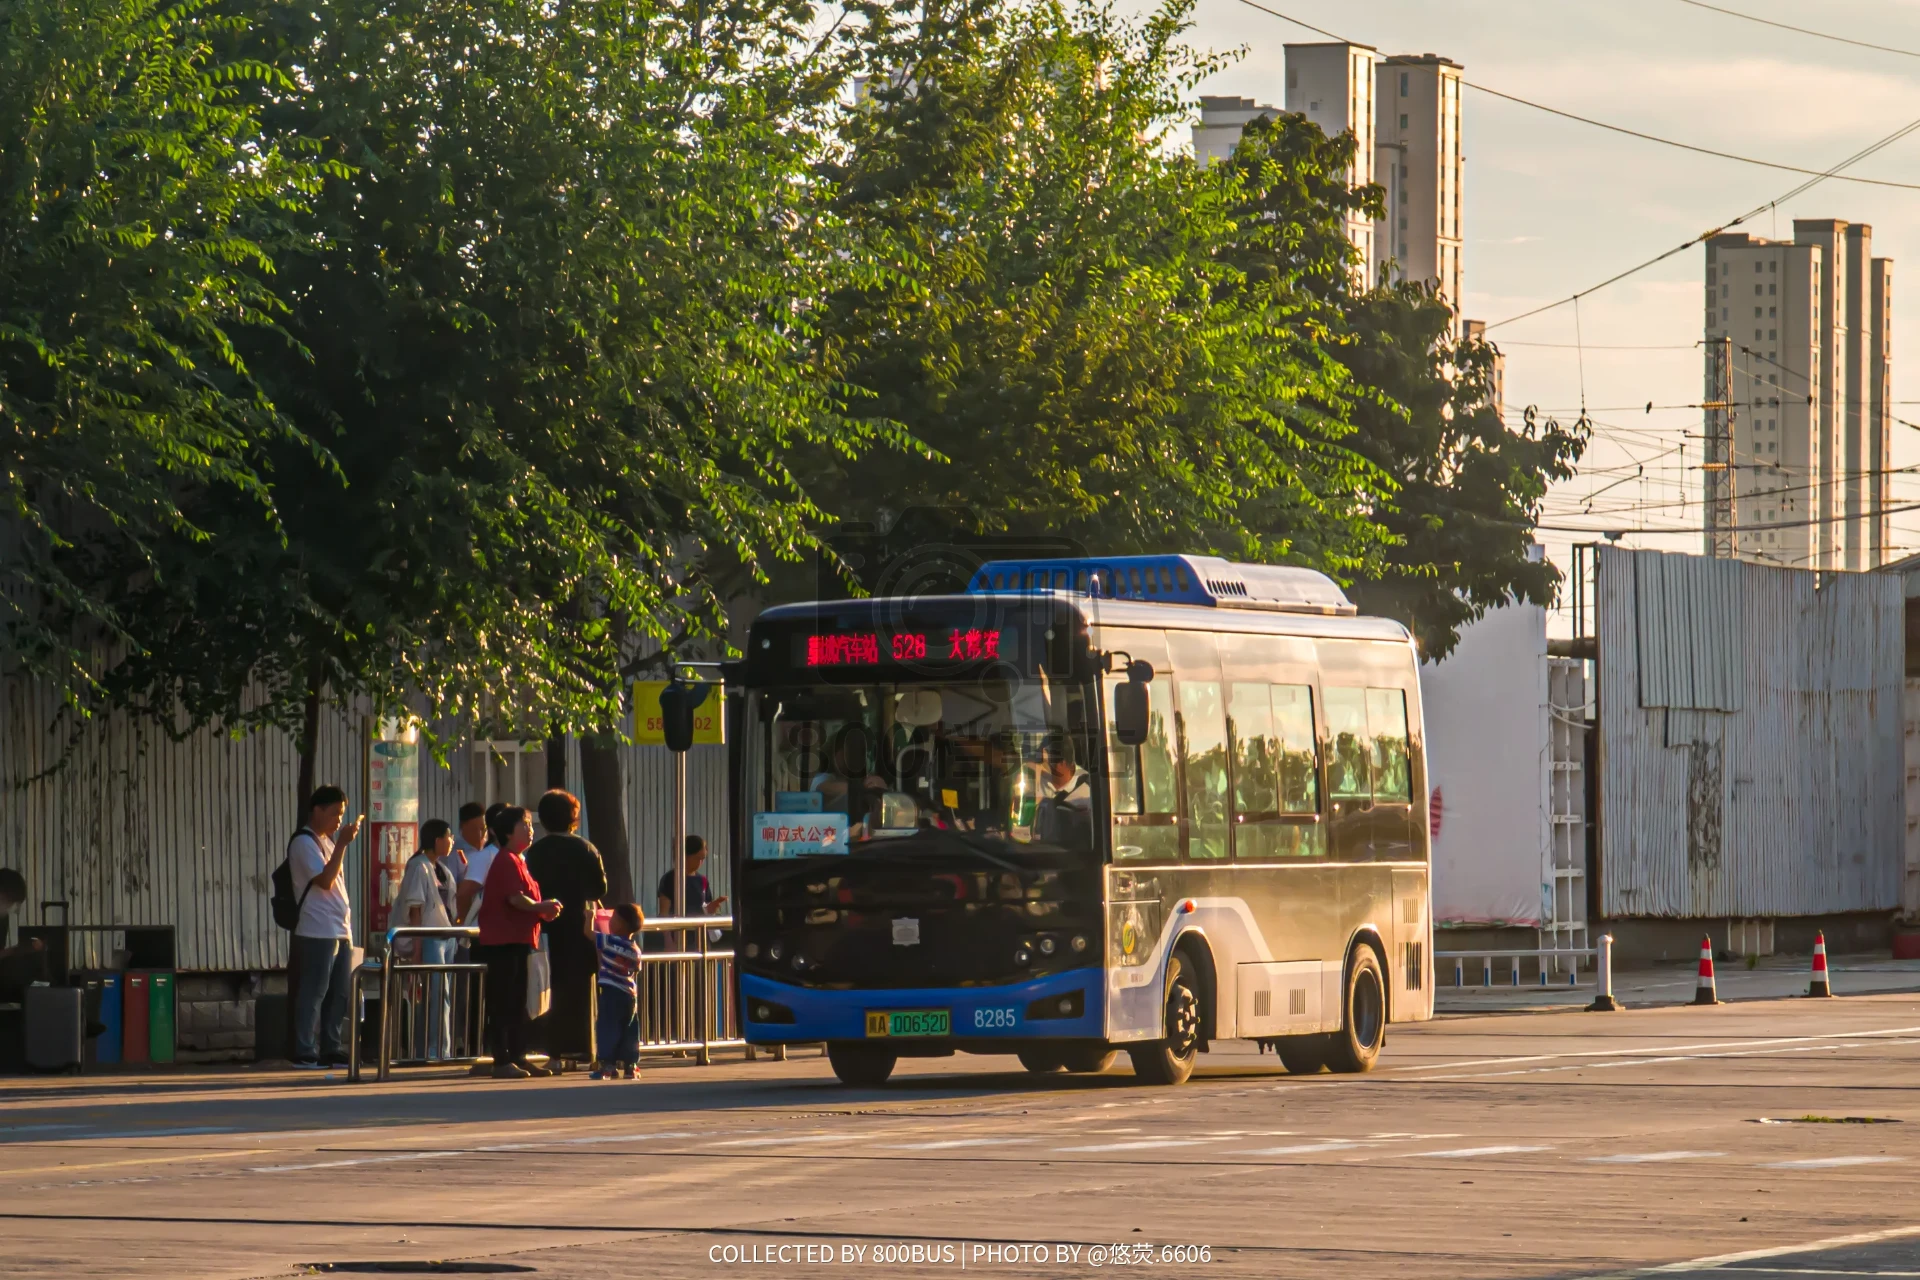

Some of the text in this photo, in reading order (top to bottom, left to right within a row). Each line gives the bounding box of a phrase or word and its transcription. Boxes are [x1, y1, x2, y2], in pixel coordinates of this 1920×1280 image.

[892, 633, 926, 660] 528
[761, 825, 837, 843] 响应式公交
[974, 1008, 1016, 1028] 8285
